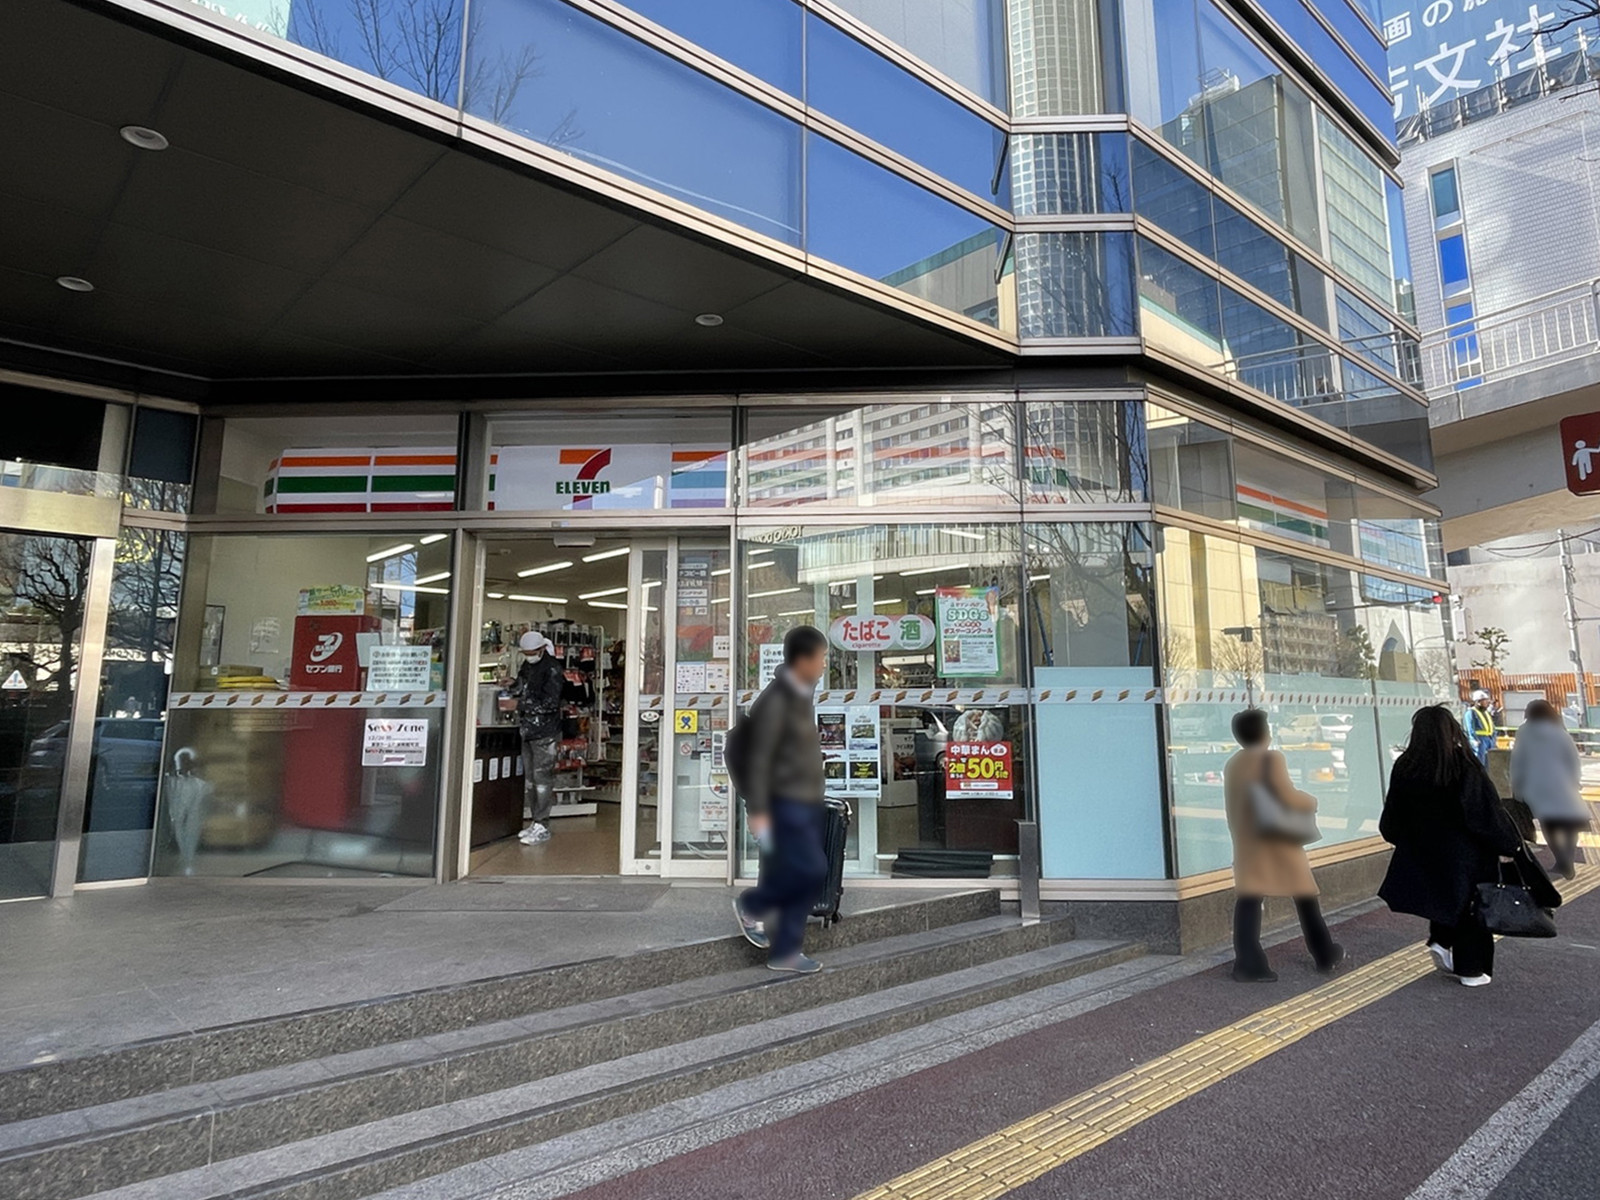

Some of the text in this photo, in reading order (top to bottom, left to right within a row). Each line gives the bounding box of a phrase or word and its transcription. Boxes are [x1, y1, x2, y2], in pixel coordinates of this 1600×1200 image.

[947, 608, 989, 621] SDGs
[843, 620, 921, 641] たばこ 酒
[950, 745, 990, 755] 中華まん
[967, 757, 995, 779] 50
